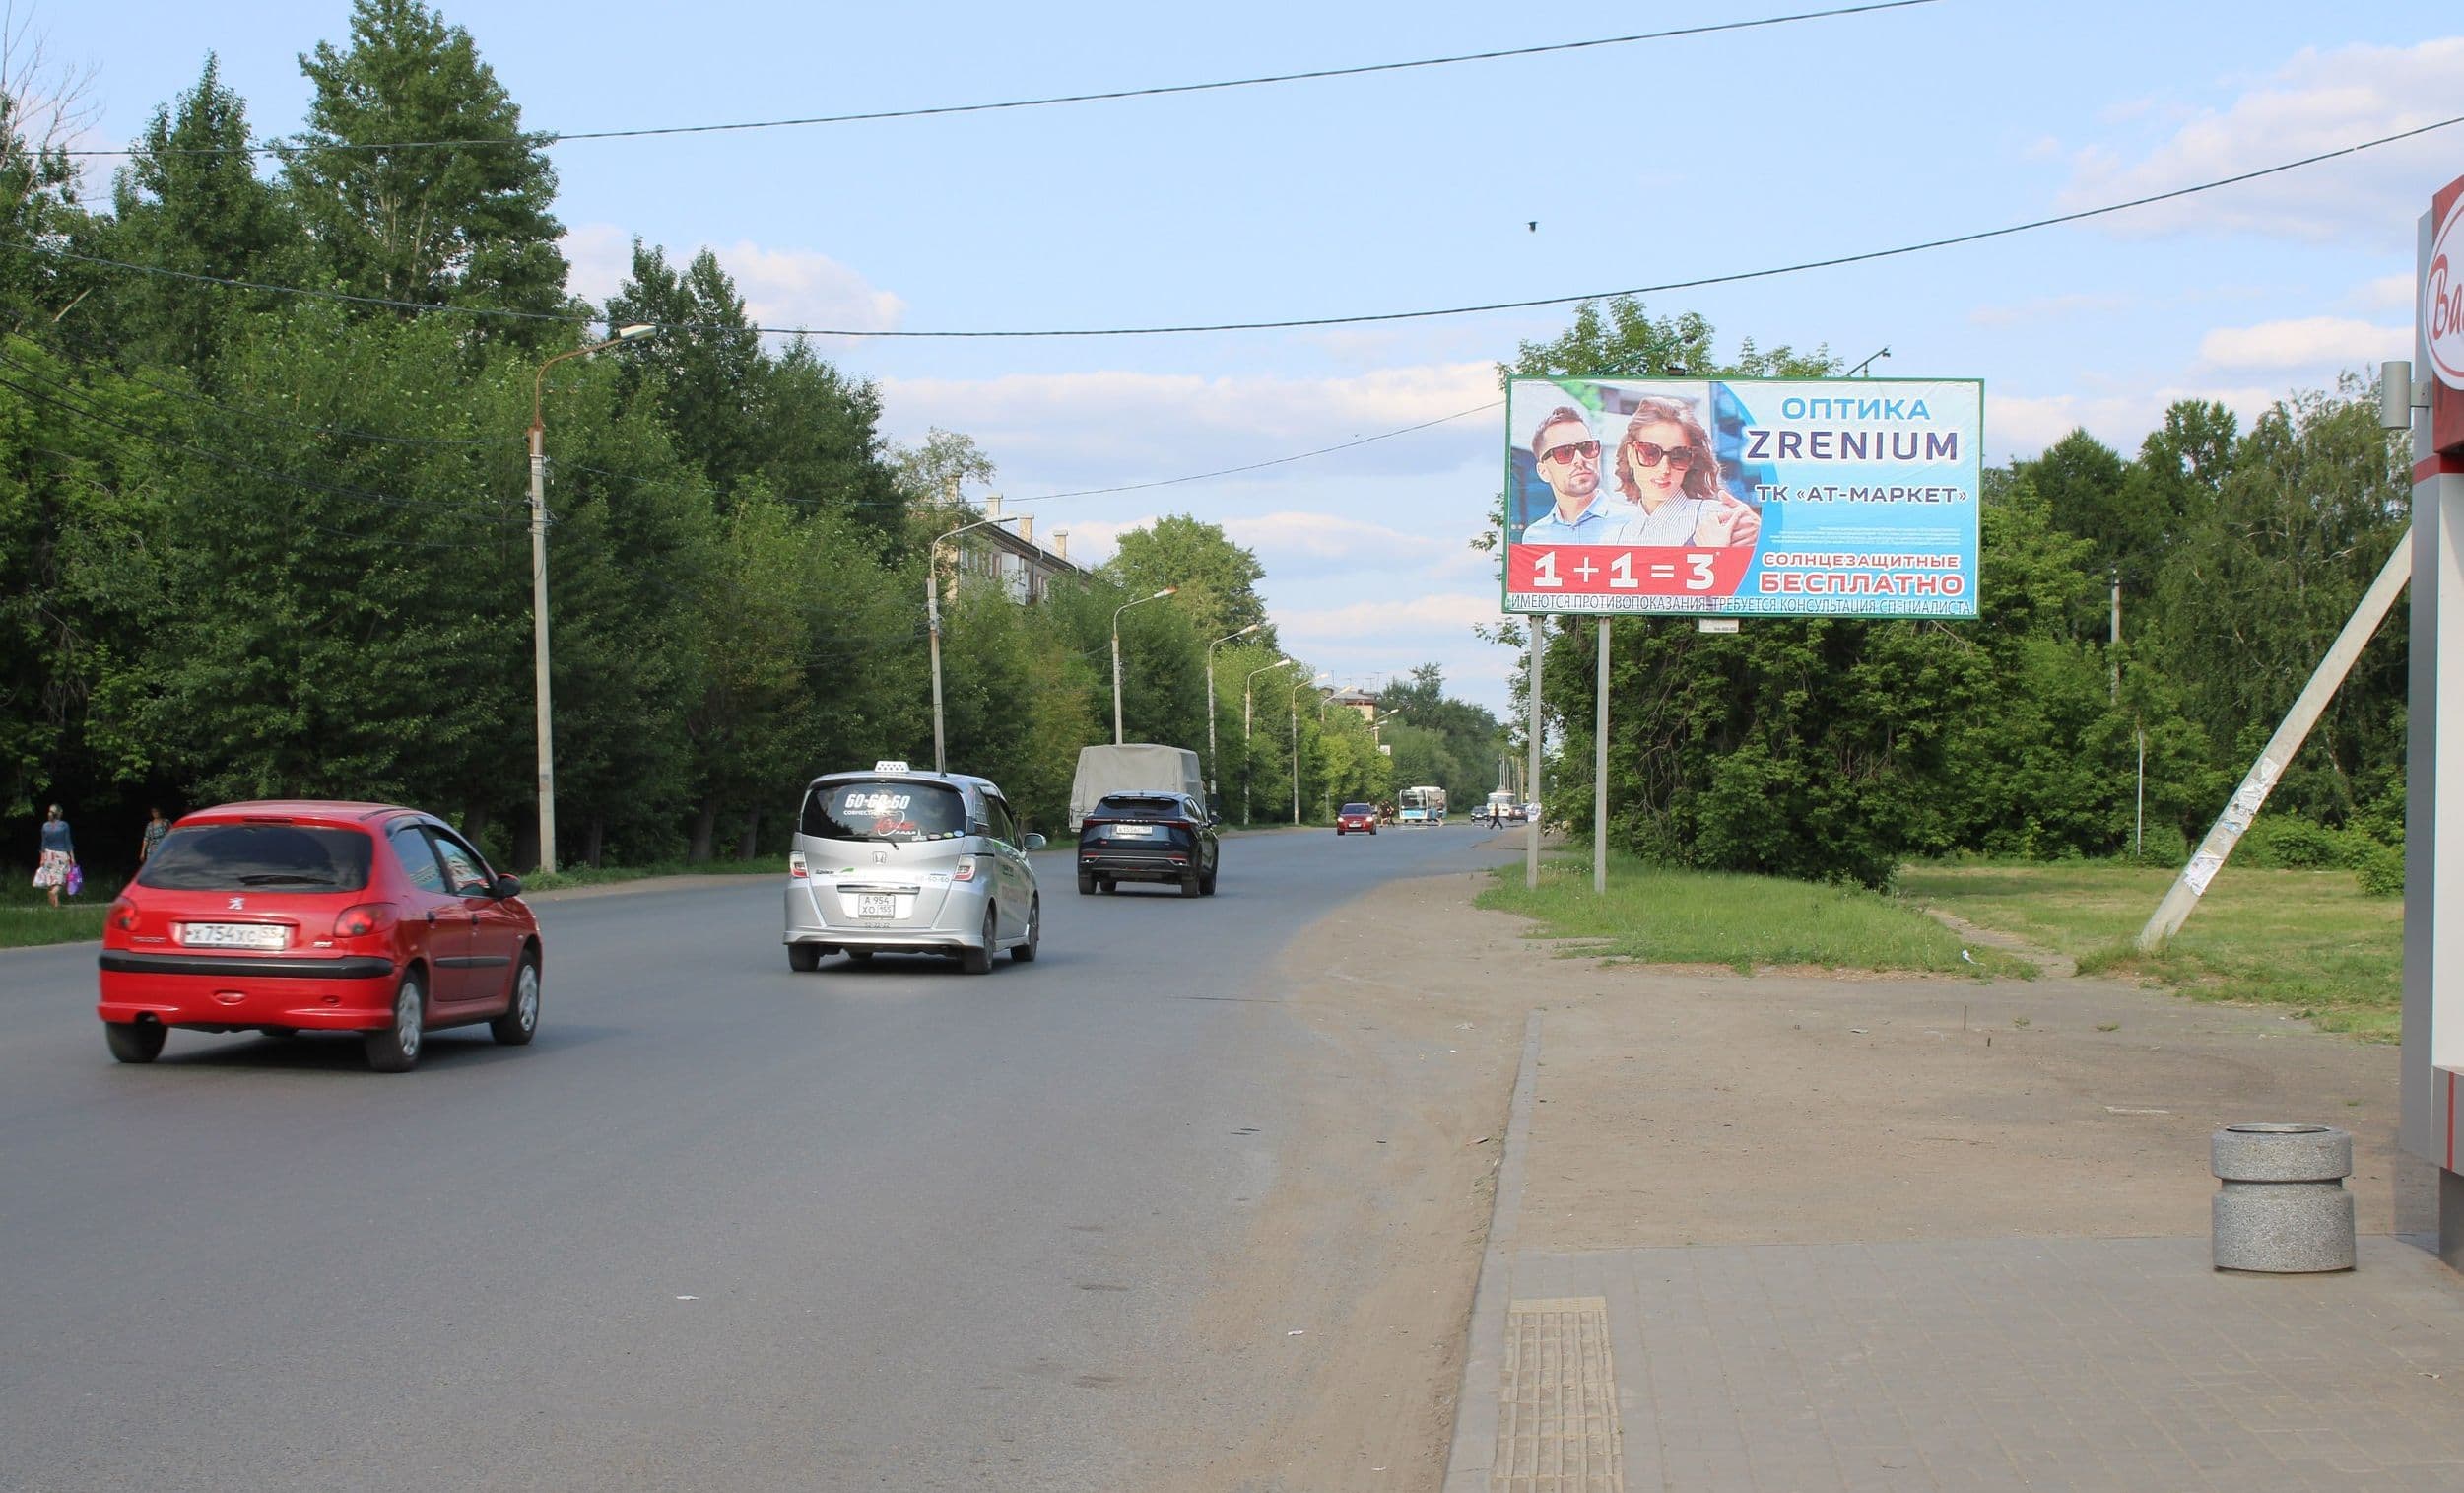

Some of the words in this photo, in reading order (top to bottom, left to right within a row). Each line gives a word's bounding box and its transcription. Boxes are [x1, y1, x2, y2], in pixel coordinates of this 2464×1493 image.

[1781, 397, 1931, 420] ОПТИКА
[1747, 430, 1958, 461] ZRENIUM
[1757, 486, 1789, 502] ТК
[1797, 487, 1967, 503] «АТ-МАРКЕТ»
[1533, 551, 1563, 587] 1
[1610, 552, 1639, 588] 1
[1763, 554, 1959, 569] СОЛНЦЕЗАЩИТНЫЕ
[1760, 574, 1964, 595] БЕСПЛАТНО
[1511, 594, 1570, 609] ИМЕЮТСЯ
[1713, 597, 1776, 611] ТРЕБУЕТСЯ
[1780, 598, 1877, 613] КОНСУЛЬТАЦИЯ
